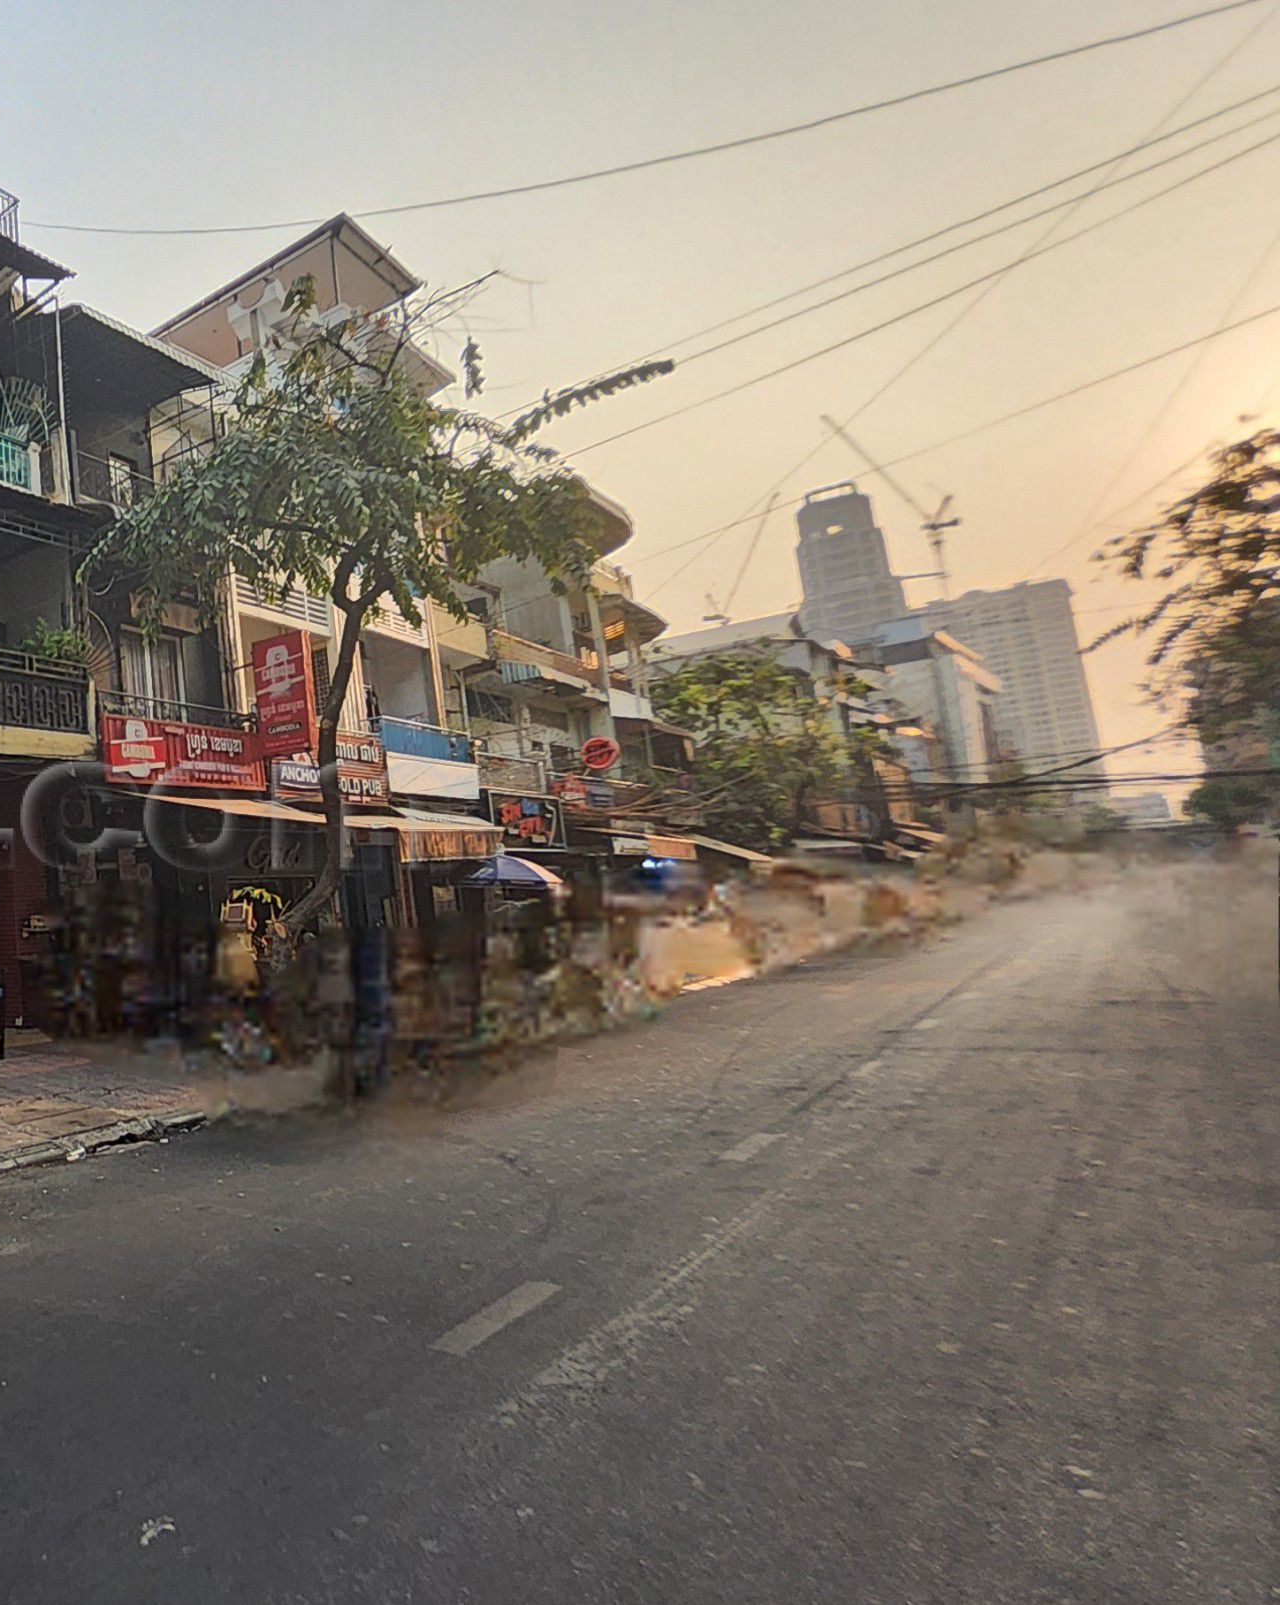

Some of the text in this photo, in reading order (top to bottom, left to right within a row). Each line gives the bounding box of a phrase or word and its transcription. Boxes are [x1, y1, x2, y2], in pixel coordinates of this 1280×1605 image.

[280, 766, 320, 784] ANCHO
[337, 777, 382, 796] OLD PUB
